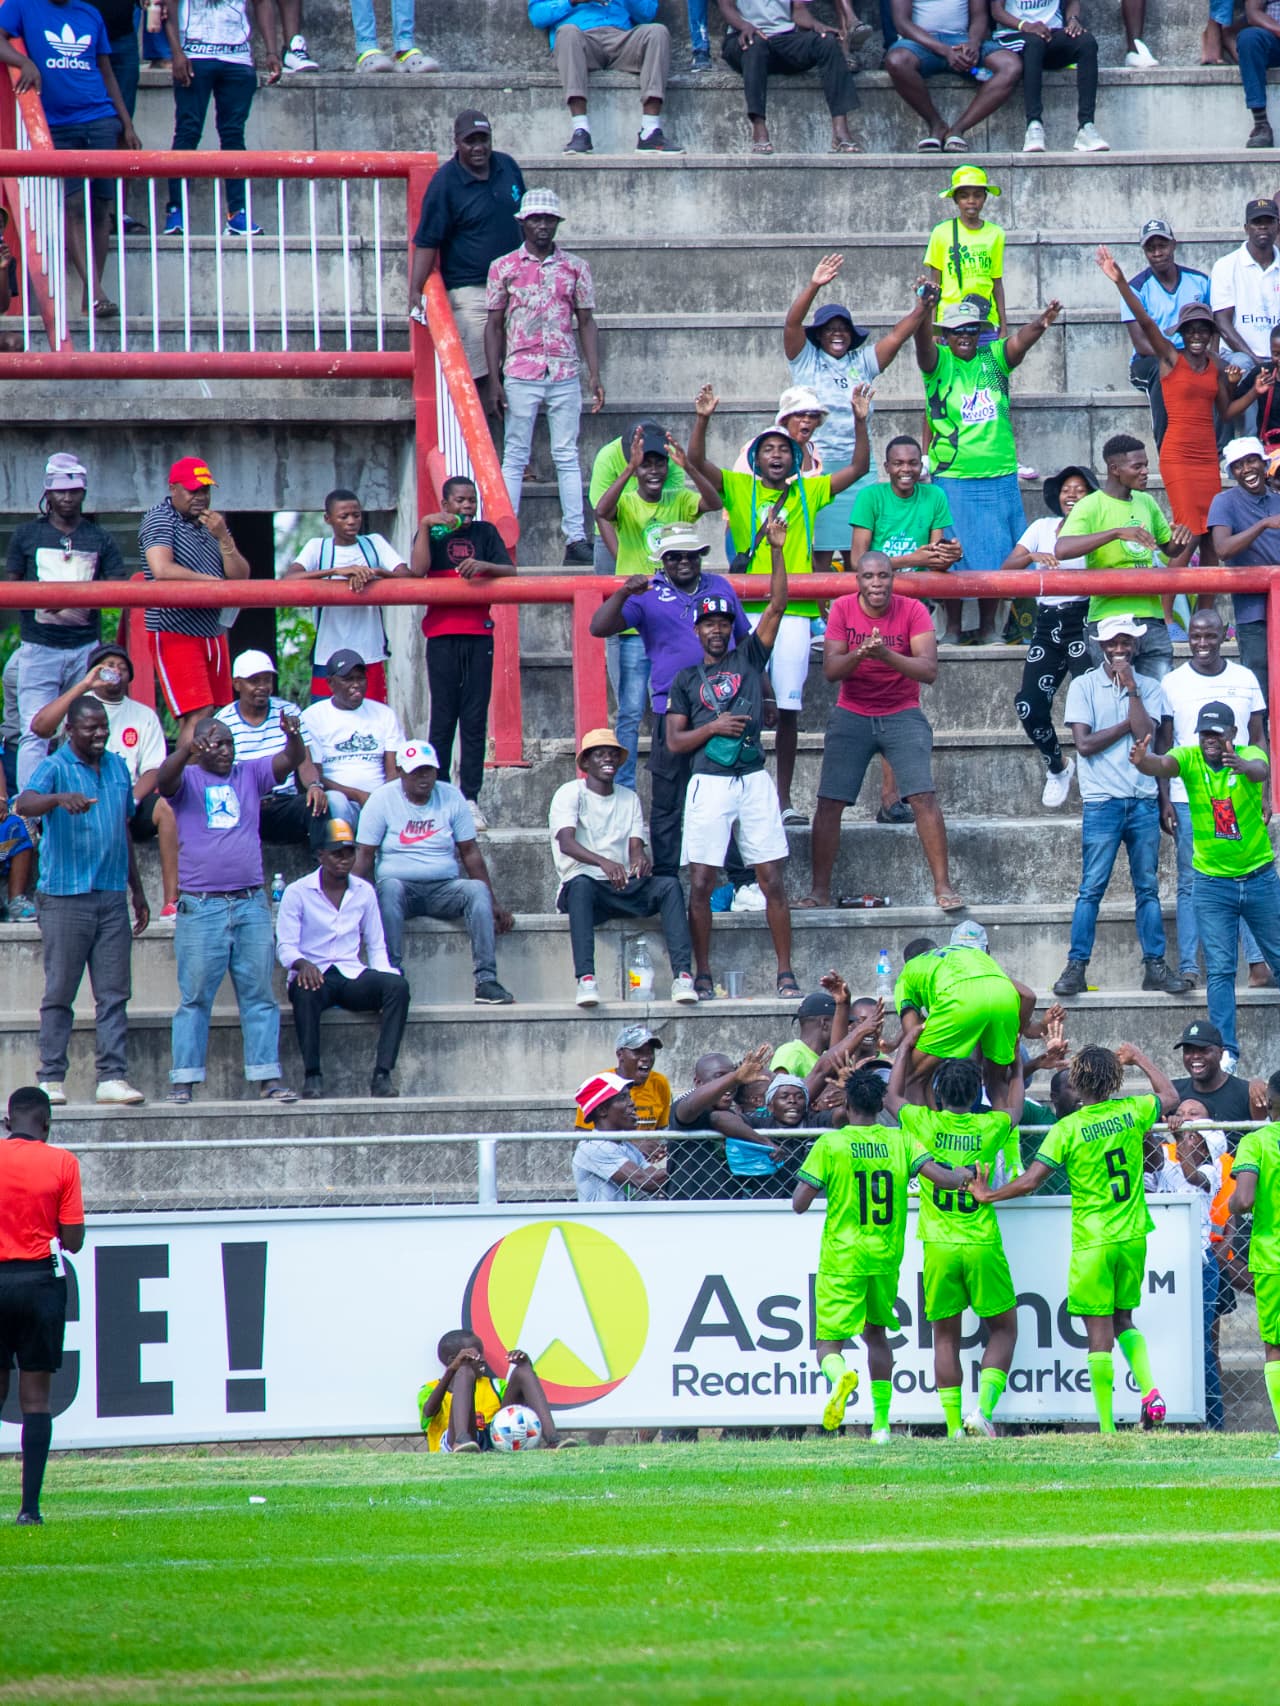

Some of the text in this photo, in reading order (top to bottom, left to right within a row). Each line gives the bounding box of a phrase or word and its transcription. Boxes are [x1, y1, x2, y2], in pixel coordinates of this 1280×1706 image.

[46, 56, 91, 71] adidas
[405, 819, 436, 835] NIKE
[1081, 1112, 1136, 1144] CIPHAS M
[851, 1142, 889, 1160] SHOKO
[935, 1131, 982, 1152] SITHOLE
[1104, 1147, 1131, 1203] 5
[854, 1169, 894, 1226] 19
